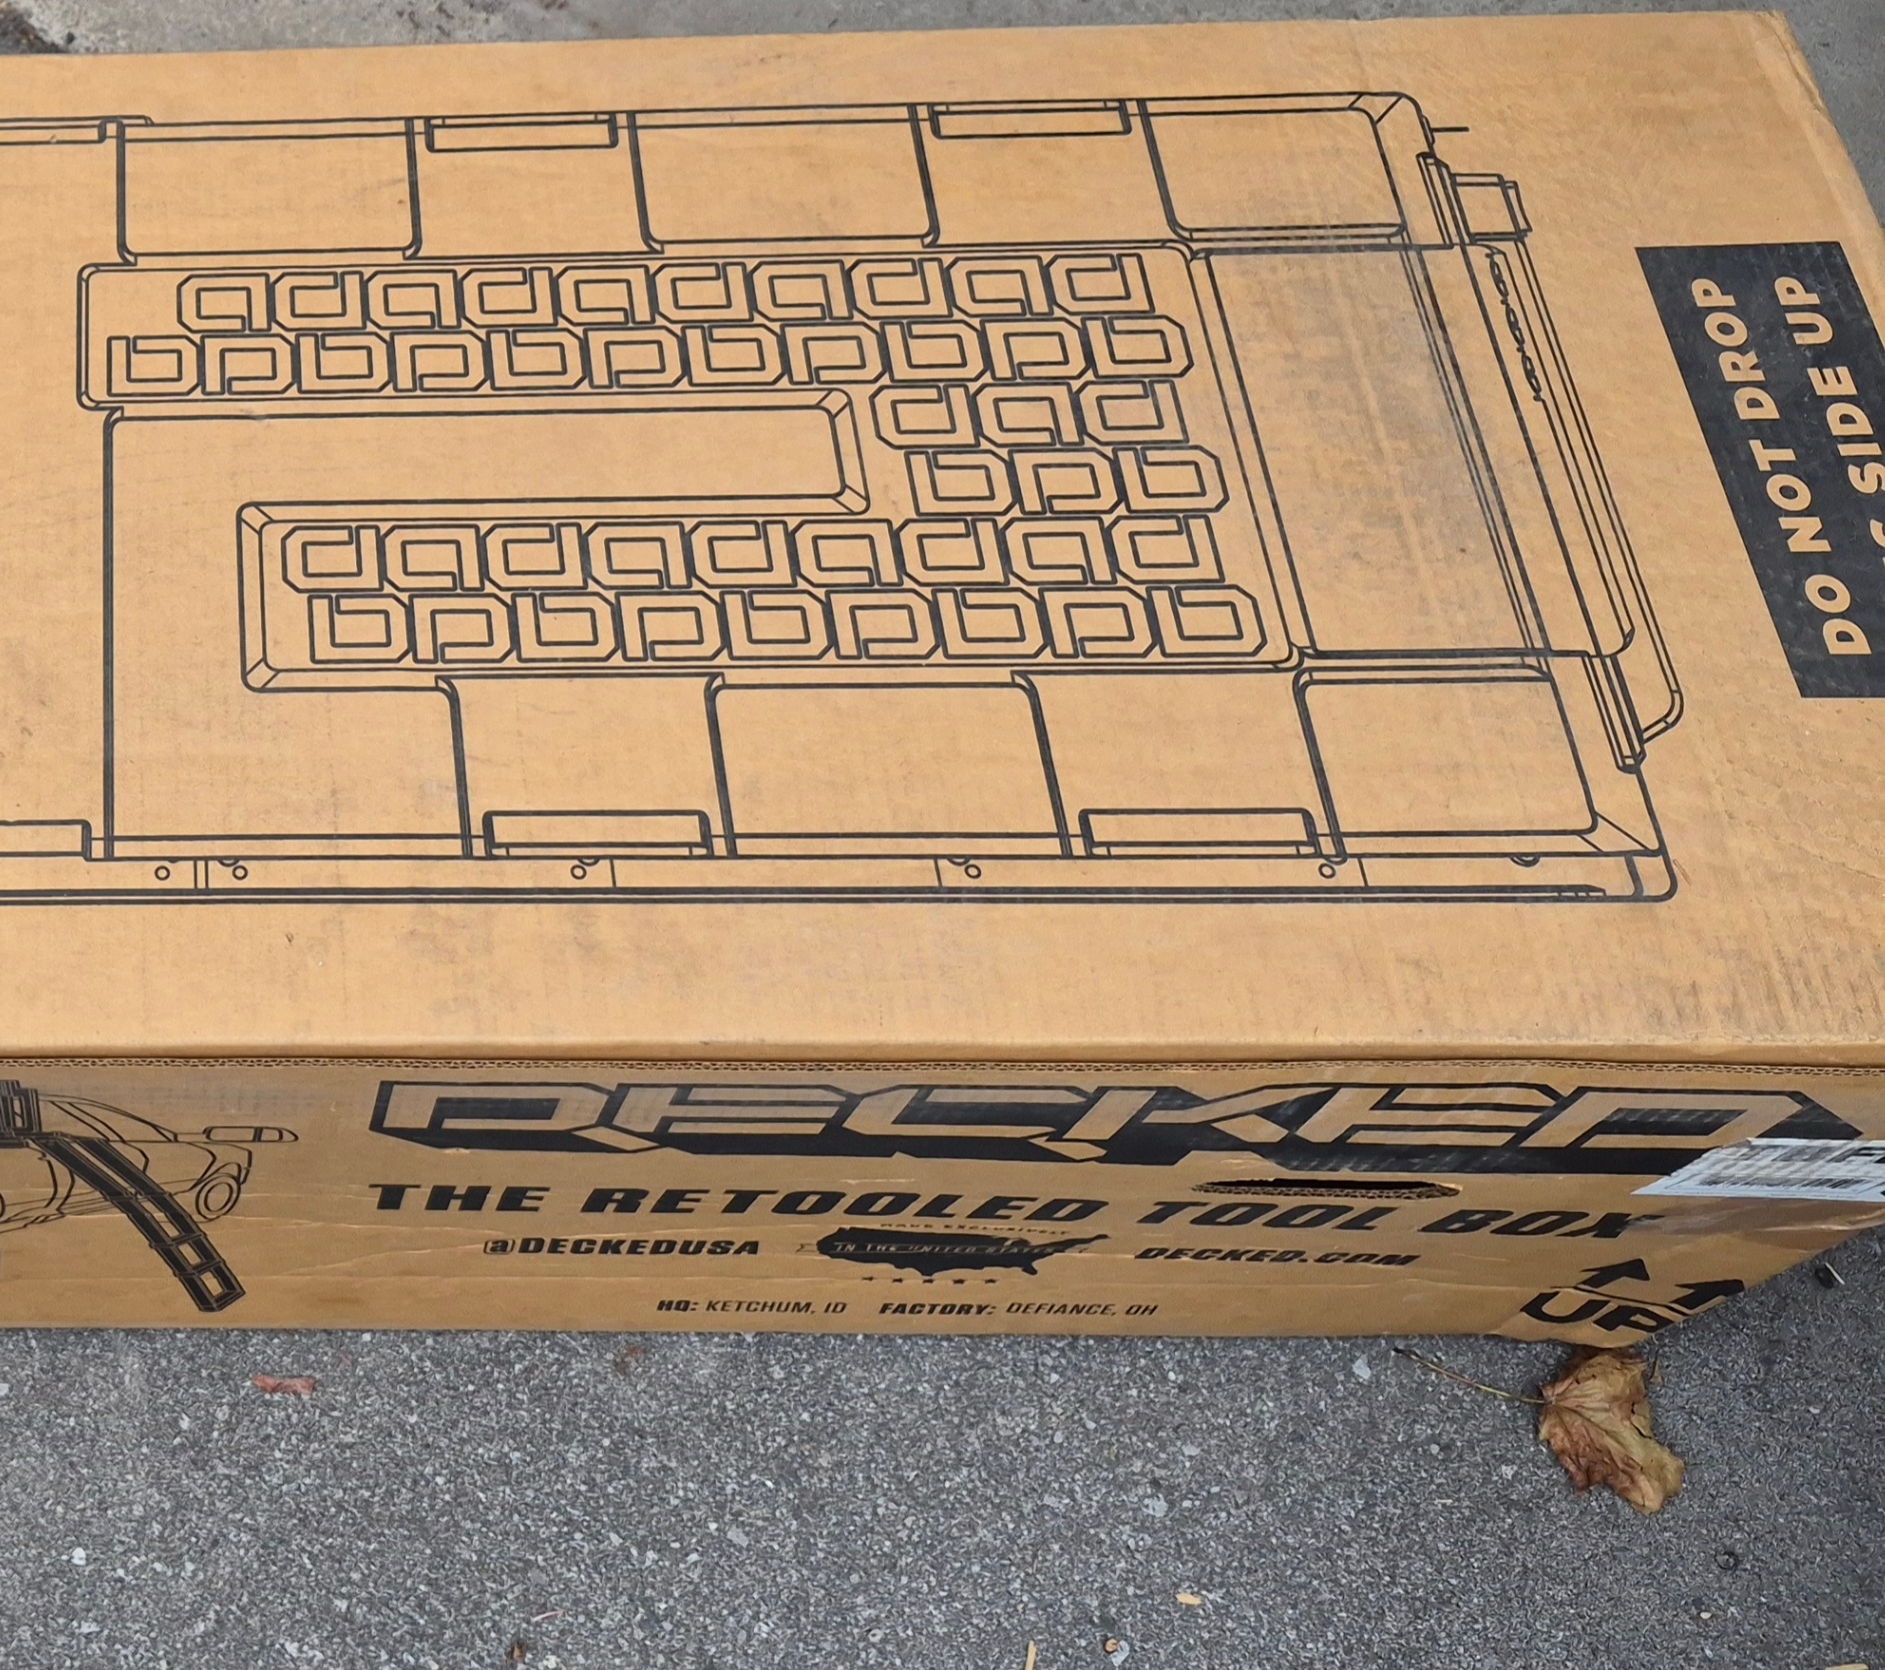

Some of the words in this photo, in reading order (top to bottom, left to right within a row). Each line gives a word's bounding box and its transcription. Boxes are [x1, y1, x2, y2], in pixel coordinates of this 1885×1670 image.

[1774, 276, 1833, 345] UP
[1691, 278, 1780, 420] DROP
[1808, 366, 1885, 494] SIDE
[1749, 439, 1832, 552] NOT
[1805, 574, 1872, 655] DO
[369, 1080, 1864, 1174] DECKED
[367, 1183, 550, 1212] THE
[579, 1187, 1110, 1222] RETOOLED
[1136, 1201, 1397, 1231] TOOL
[1417, 1209, 1665, 1239] BOX
[483, 1236, 760, 1256] @DECKEDUSA
[1134, 1247, 1421, 1267] DECKED.COM
[656, 1299, 699, 1313] HQ:
[706, 1300, 816, 1315] KETCHUM,
[823, 1301, 847, 1315] ID
[878, 1302, 996, 1316] FACTORY:
[1006, 1302, 1117, 1317] DEFIANCE,
[1125, 1304, 1159, 1317] OH
[1519, 1290, 1676, 1334] UP
